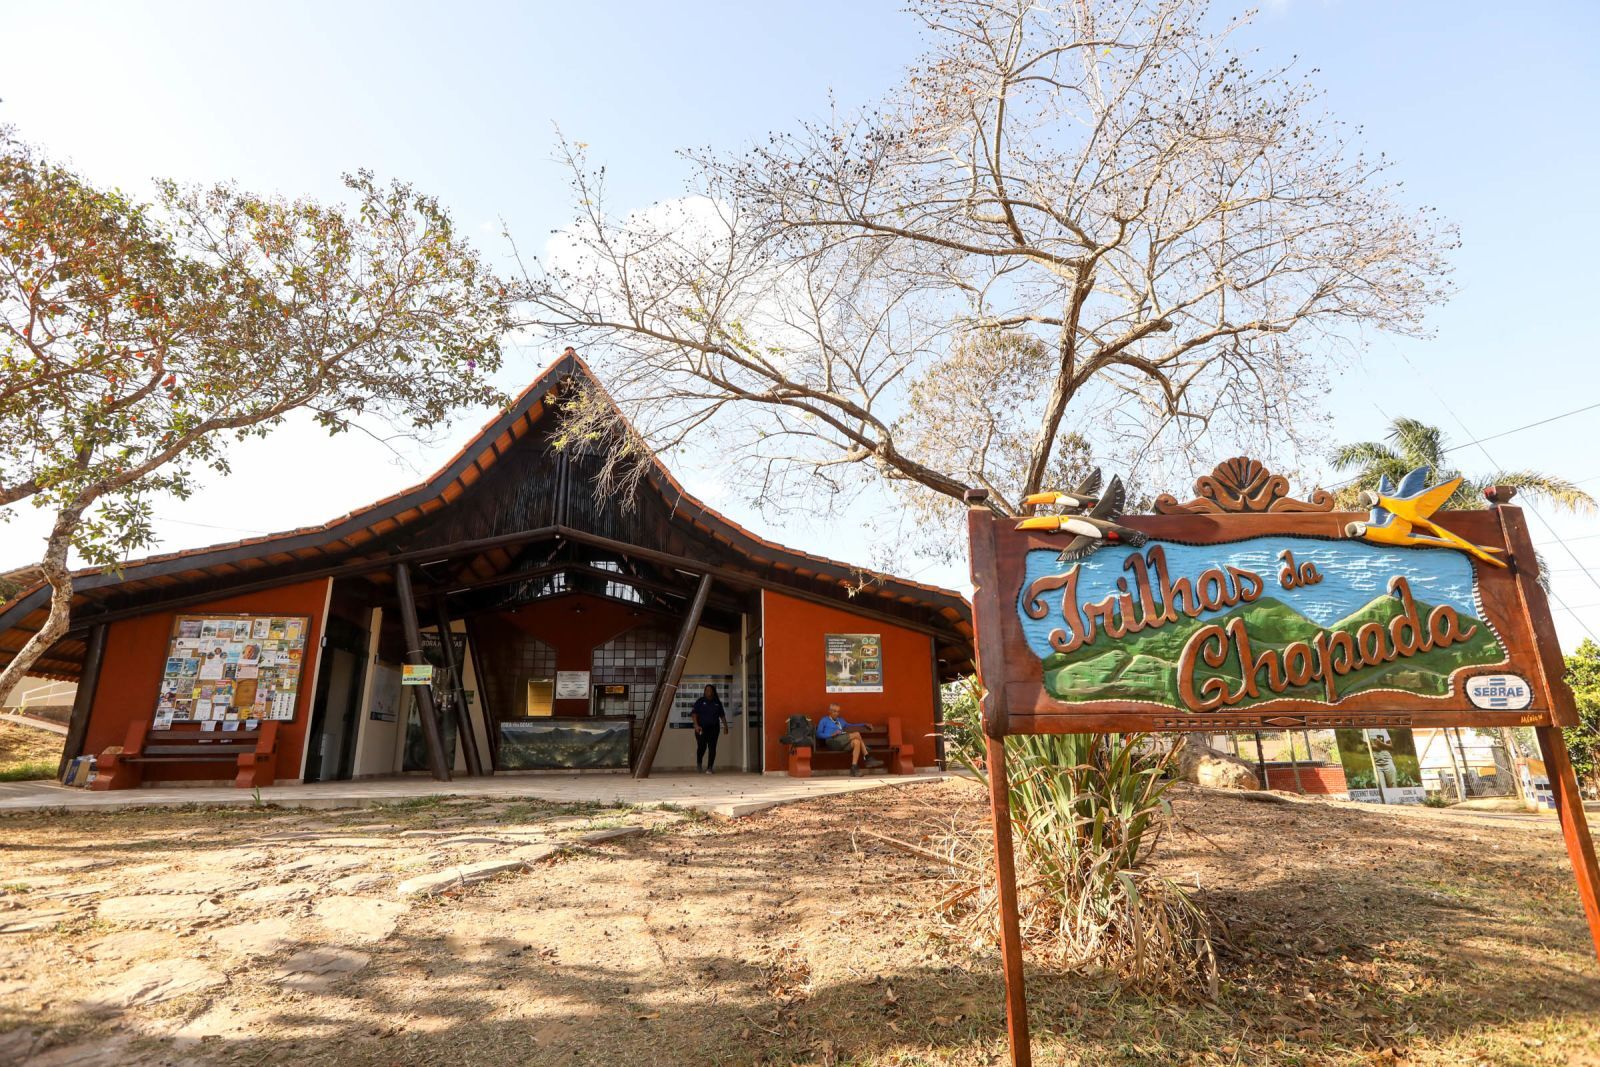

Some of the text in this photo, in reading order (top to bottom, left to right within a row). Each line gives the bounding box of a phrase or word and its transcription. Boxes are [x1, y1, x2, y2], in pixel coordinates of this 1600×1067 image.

[1023, 544, 1323, 653] Trilhas da
[1177, 575, 1477, 712] Chapada
[1473, 687, 1524, 697] SEBRAE
